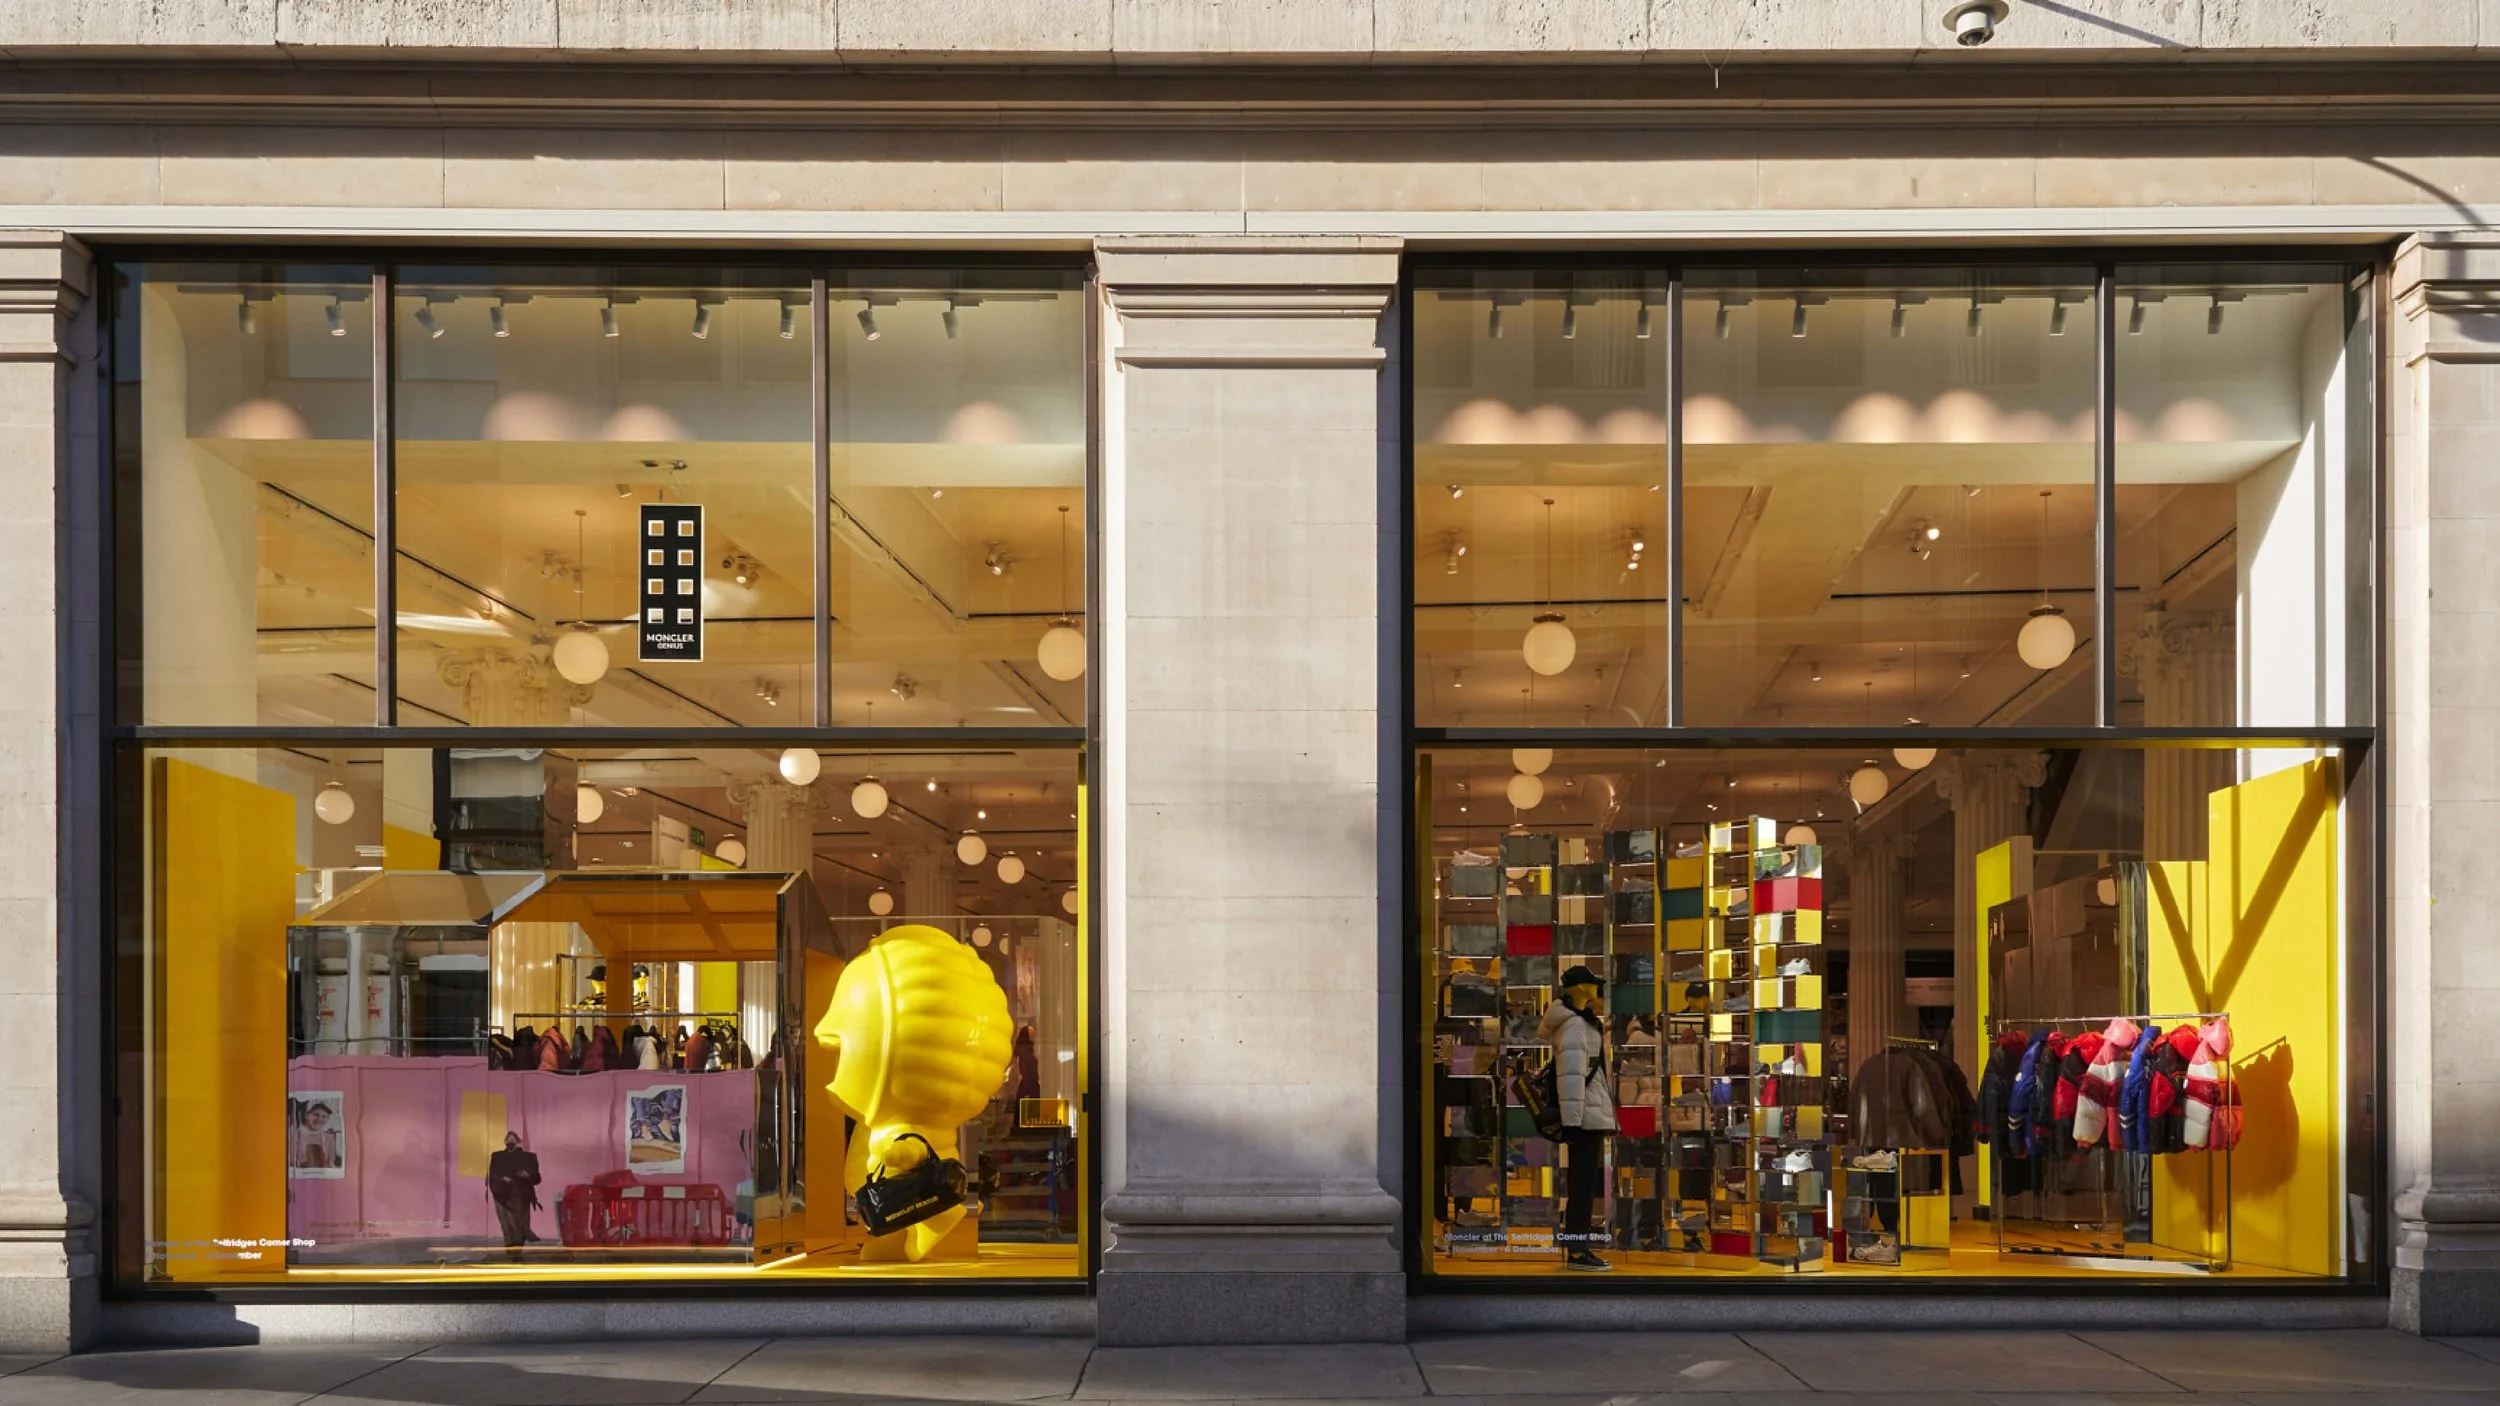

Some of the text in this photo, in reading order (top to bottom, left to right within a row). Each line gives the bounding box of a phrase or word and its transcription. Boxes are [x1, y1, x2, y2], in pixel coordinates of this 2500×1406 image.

[646, 633, 695, 642] MONCLER
[656, 642, 684, 650] GENIUS
[1444, 1232, 1612, 1242] Moncler at The Selfridges Corner Shop
[259, 1238, 291, 1247] Corner
[292, 1238, 316, 1248] Shop
